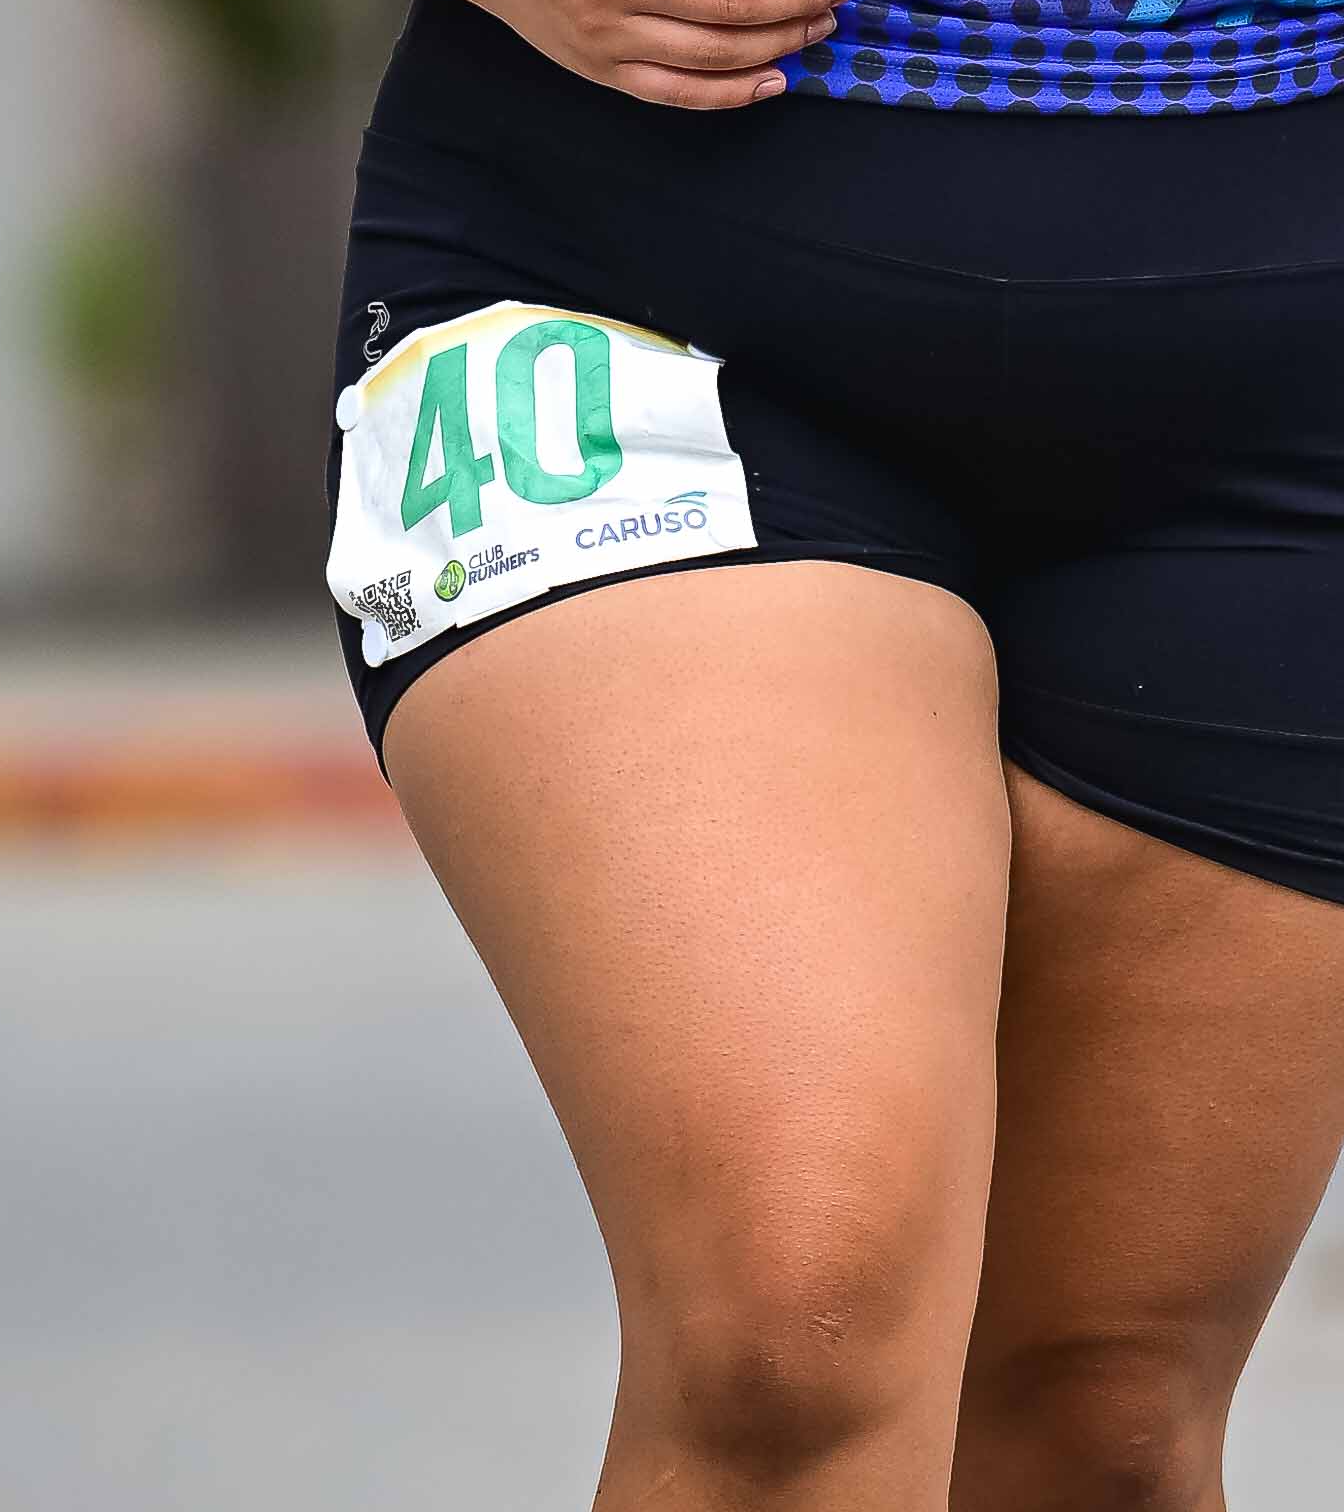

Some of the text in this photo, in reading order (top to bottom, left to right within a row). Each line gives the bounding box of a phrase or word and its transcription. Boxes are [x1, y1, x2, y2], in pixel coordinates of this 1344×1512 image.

[401, 320, 623, 537] 40
[575, 508, 707, 549] CARUSO
[468, 544, 503, 569] CLUB
[468, 547, 540, 586] RUNNER'S
